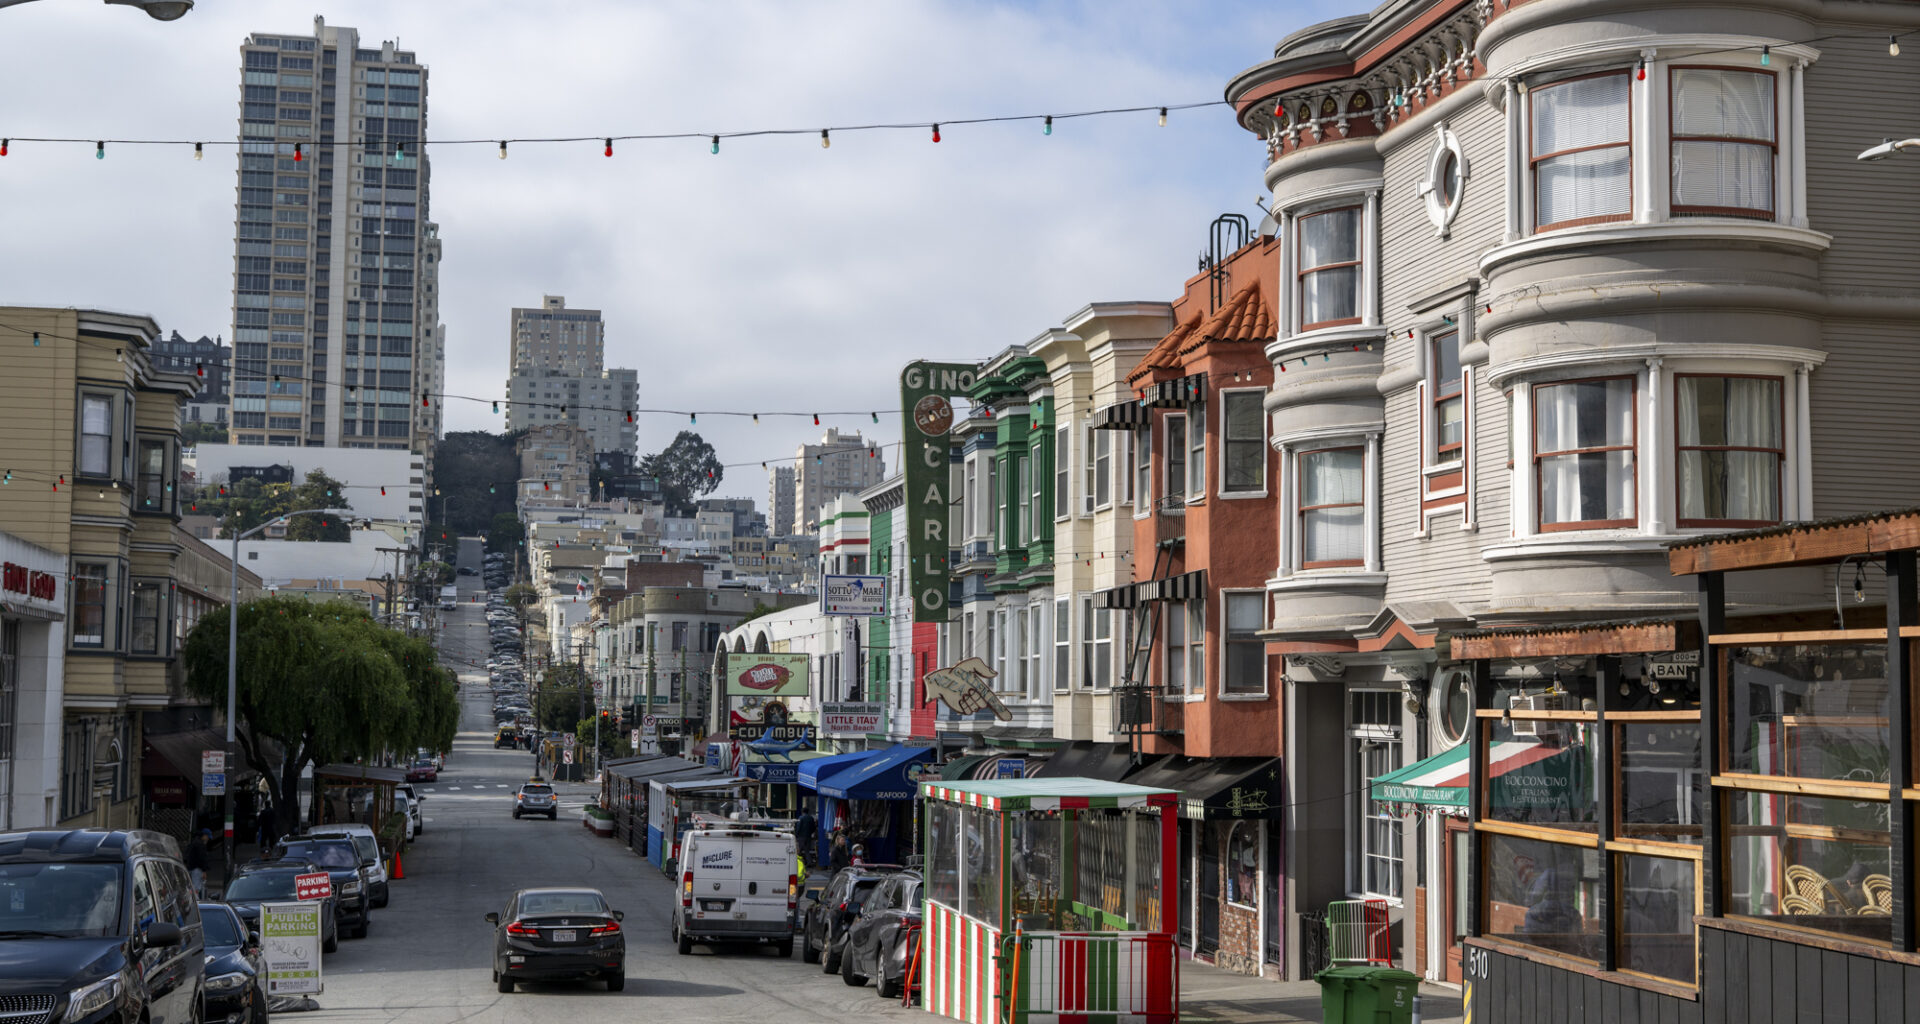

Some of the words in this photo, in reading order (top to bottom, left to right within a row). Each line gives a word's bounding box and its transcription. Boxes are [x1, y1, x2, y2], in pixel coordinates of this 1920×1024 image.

[905, 367, 976, 392] GINO
[918, 403, 950, 426] and
[921, 446, 944, 611] CARLO
[827, 586, 852, 595] SOTTO
[862, 587, 883, 596] MARE
[1657, 664, 1685, 676] BAN
[867, 705, 881, 713] Hotel
[826, 716, 854, 724] LITTLE
[857, 716, 879, 724] ITALY
[768, 768, 795, 776] SOTTO
[1504, 775, 1567, 787] BOCCONCINO
[876, 791, 908, 799] SEAFOOD
[1383, 785, 1418, 800] BOCCONCINO
[1422, 788, 1455, 801] RESTAURANT
[297, 876, 329, 887] PARKING
[271, 912, 312, 922] PUBLIC
[266, 922, 316, 931] PARKING
[1469, 947, 1488, 979] 510
